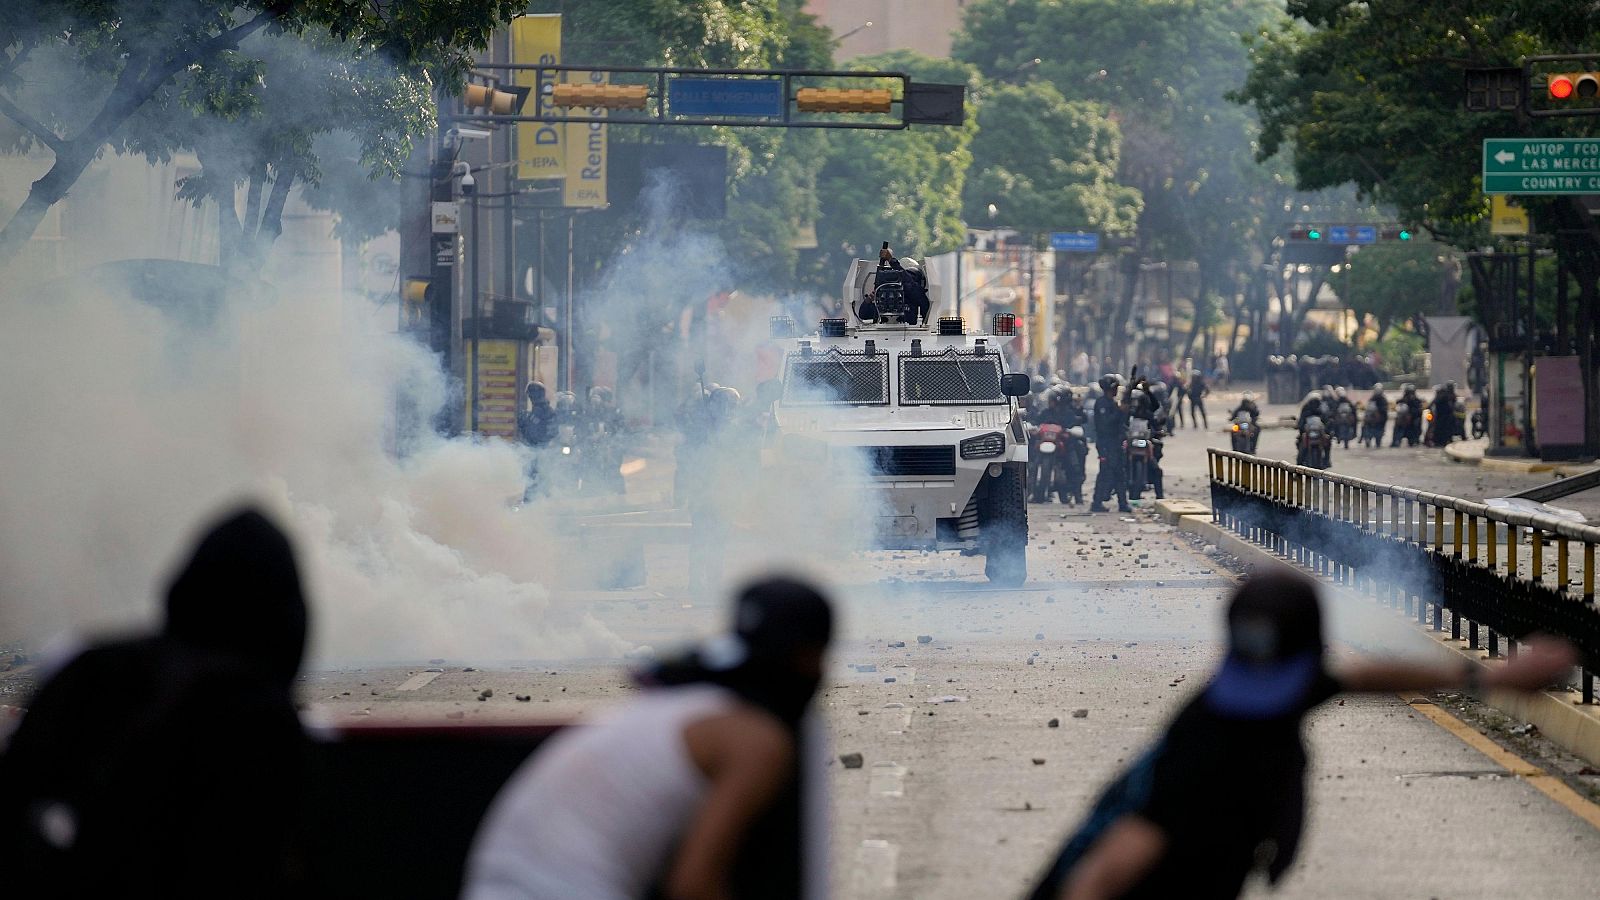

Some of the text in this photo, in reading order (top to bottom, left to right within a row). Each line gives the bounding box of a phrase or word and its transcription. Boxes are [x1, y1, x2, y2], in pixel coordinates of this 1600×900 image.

[532, 157, 558, 168] EPA
[1521, 158, 1548, 170] LAS
[1521, 177, 1582, 190] COUNTRY
[576, 189, 599, 199] EPA
